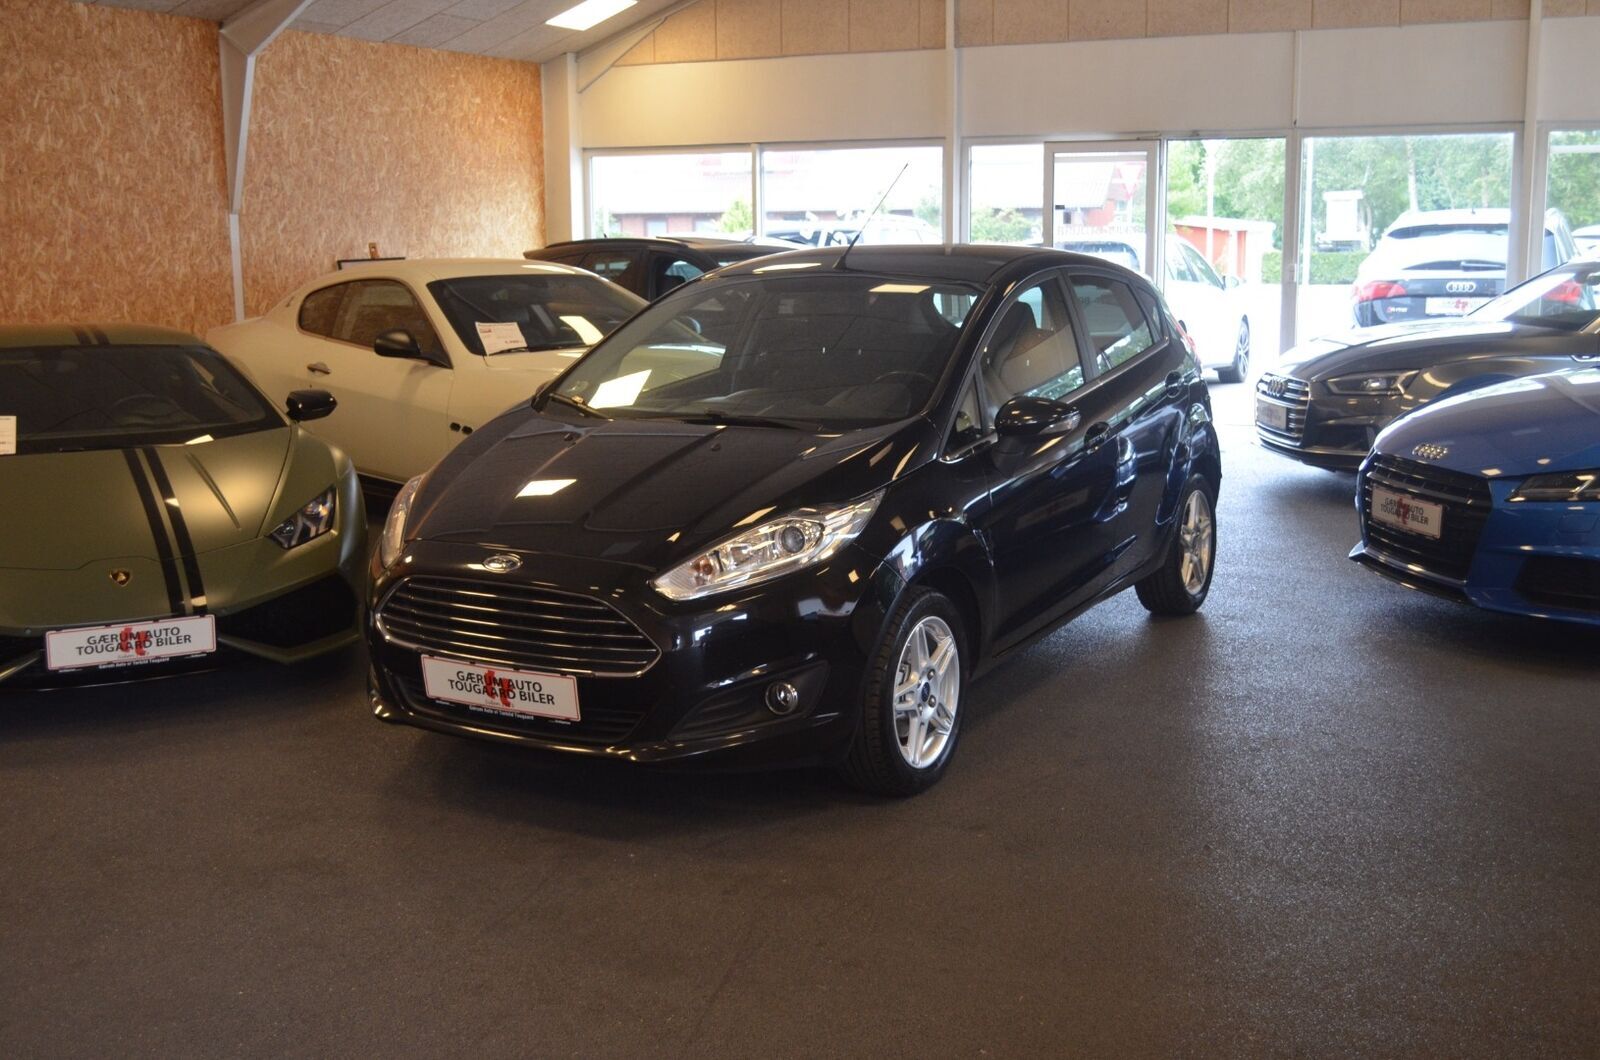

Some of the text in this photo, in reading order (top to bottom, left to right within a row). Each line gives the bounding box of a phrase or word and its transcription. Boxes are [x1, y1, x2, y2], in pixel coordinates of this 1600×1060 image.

[1380, 503, 1429, 525] TOUGD BILER
[76, 634, 192, 656] TOUGAARD BILER
[87, 626, 180, 646] GÆRUM AUTO
[448, 679, 556, 706] TOUGAARD BILER
[456, 670, 543, 693] GÆRUM AUTO
